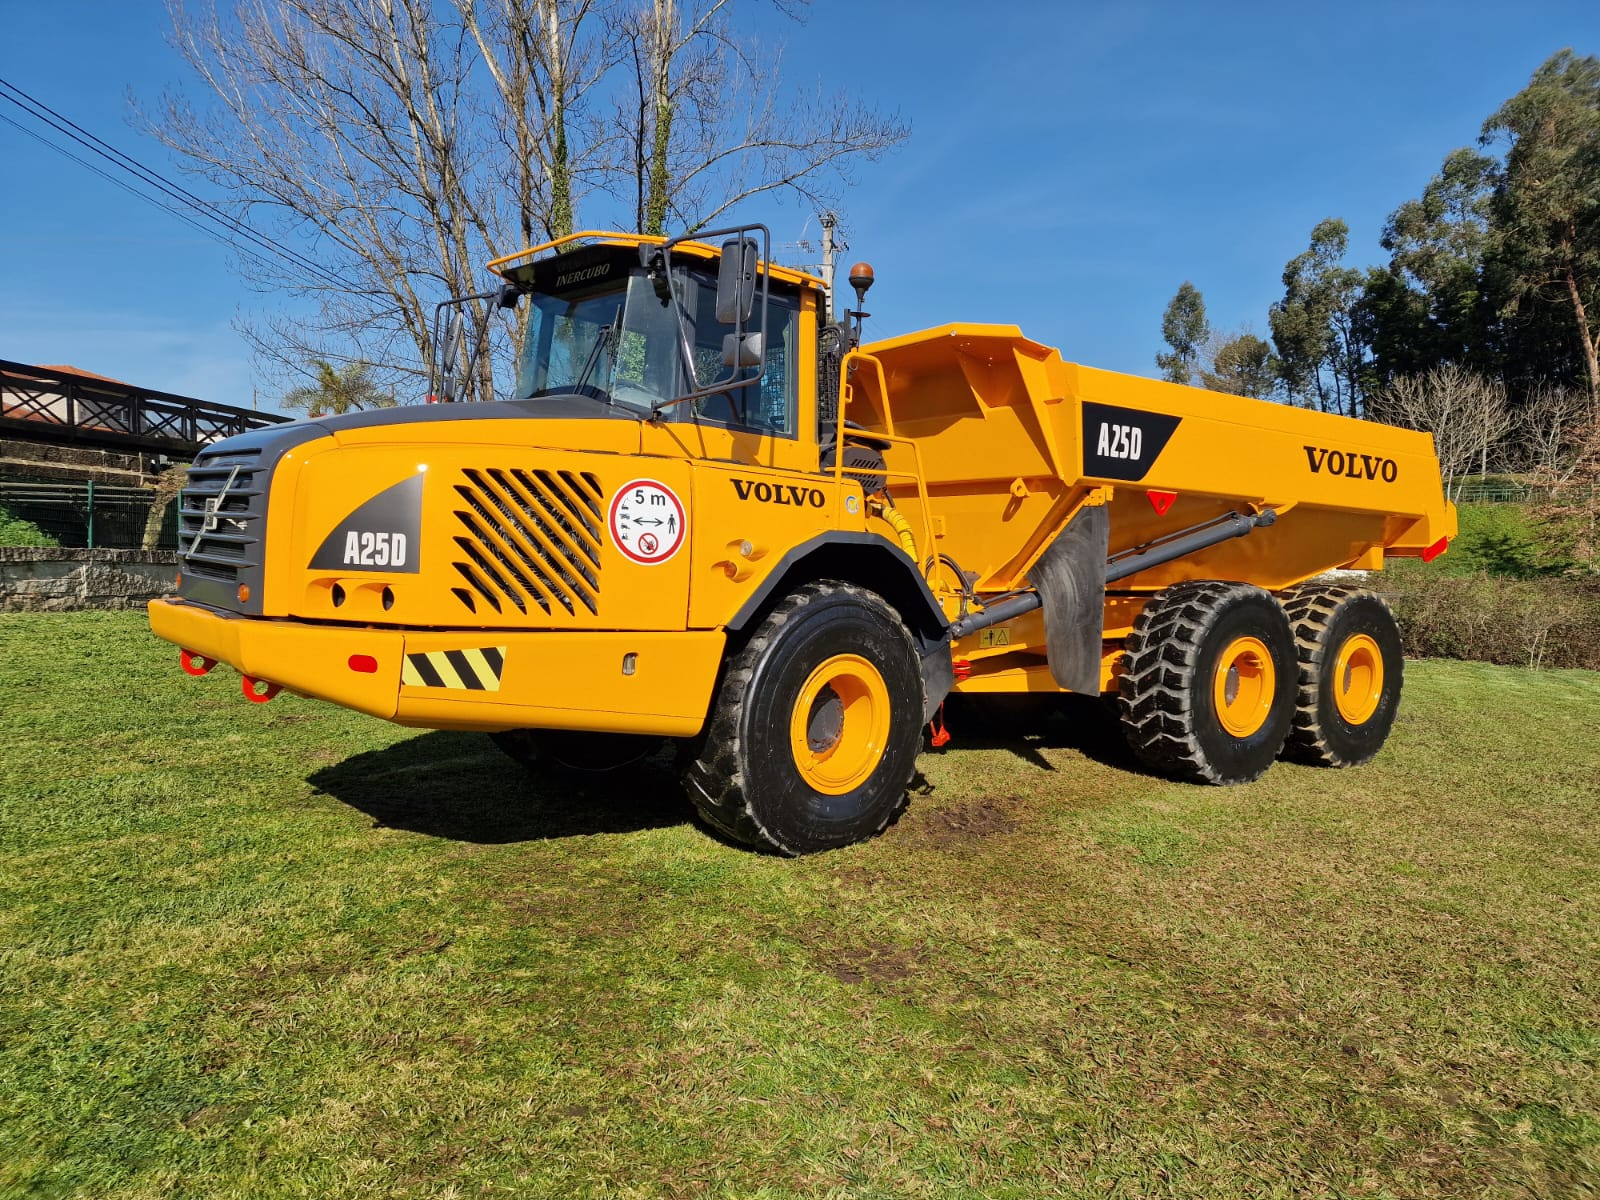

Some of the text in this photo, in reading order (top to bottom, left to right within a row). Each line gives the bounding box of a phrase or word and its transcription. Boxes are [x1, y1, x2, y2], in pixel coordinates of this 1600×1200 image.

[555, 263, 610, 288] INERCUBO
[1097, 422, 1142, 460] A25D
[1303, 445, 1398, 483] VOLVO
[635, 489, 666, 507] 5 m
[729, 478, 826, 508] VOLVO
[343, 530, 407, 567] A25D
